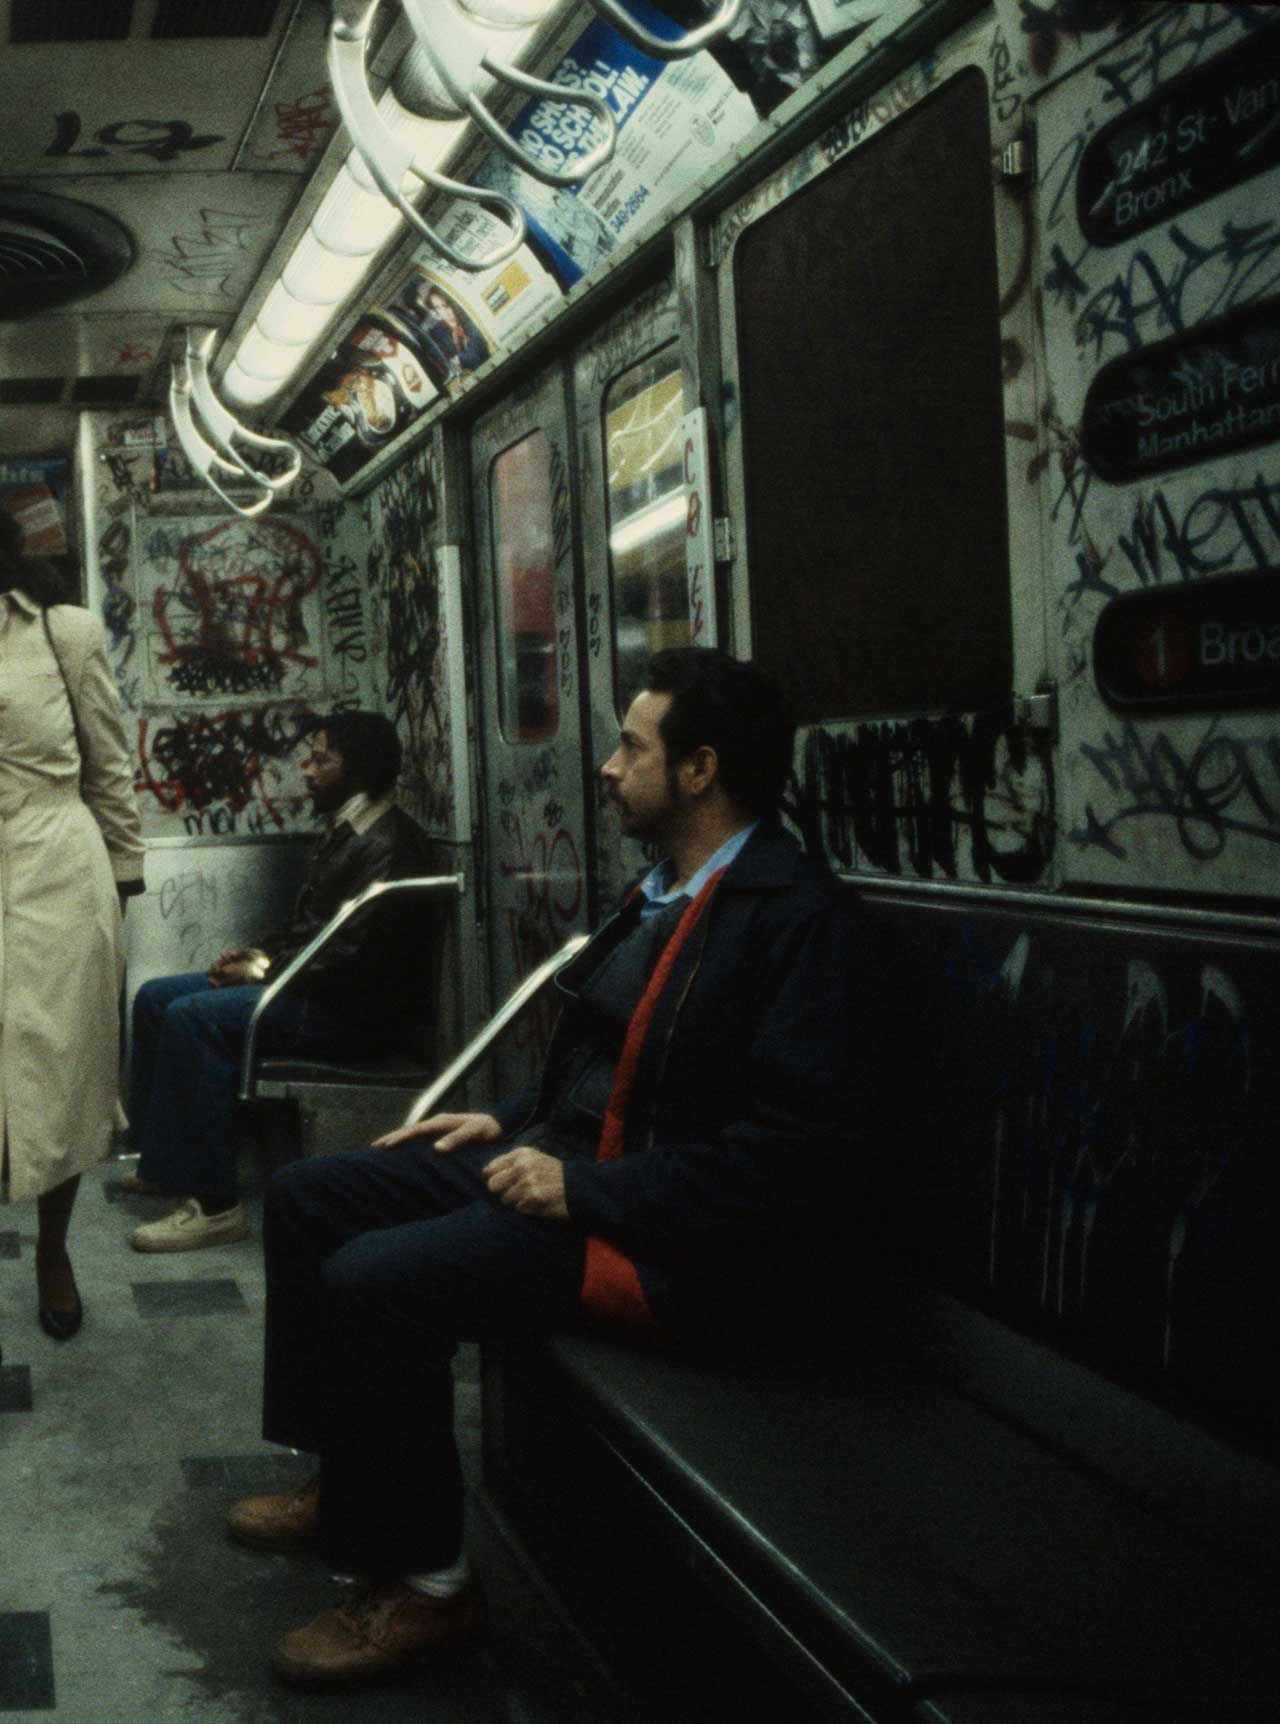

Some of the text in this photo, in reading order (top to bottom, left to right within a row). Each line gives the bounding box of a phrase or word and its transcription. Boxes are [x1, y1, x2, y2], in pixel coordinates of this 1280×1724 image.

[530, 58, 578, 135] SHS?
[552, 60, 618, 149] SCHOL!
[1115, 131, 1168, 186] 242
[1115, 168, 1192, 226] Bronx
[1136, 372, 1215, 427] South
[1151, 622, 1167, 677] 1
